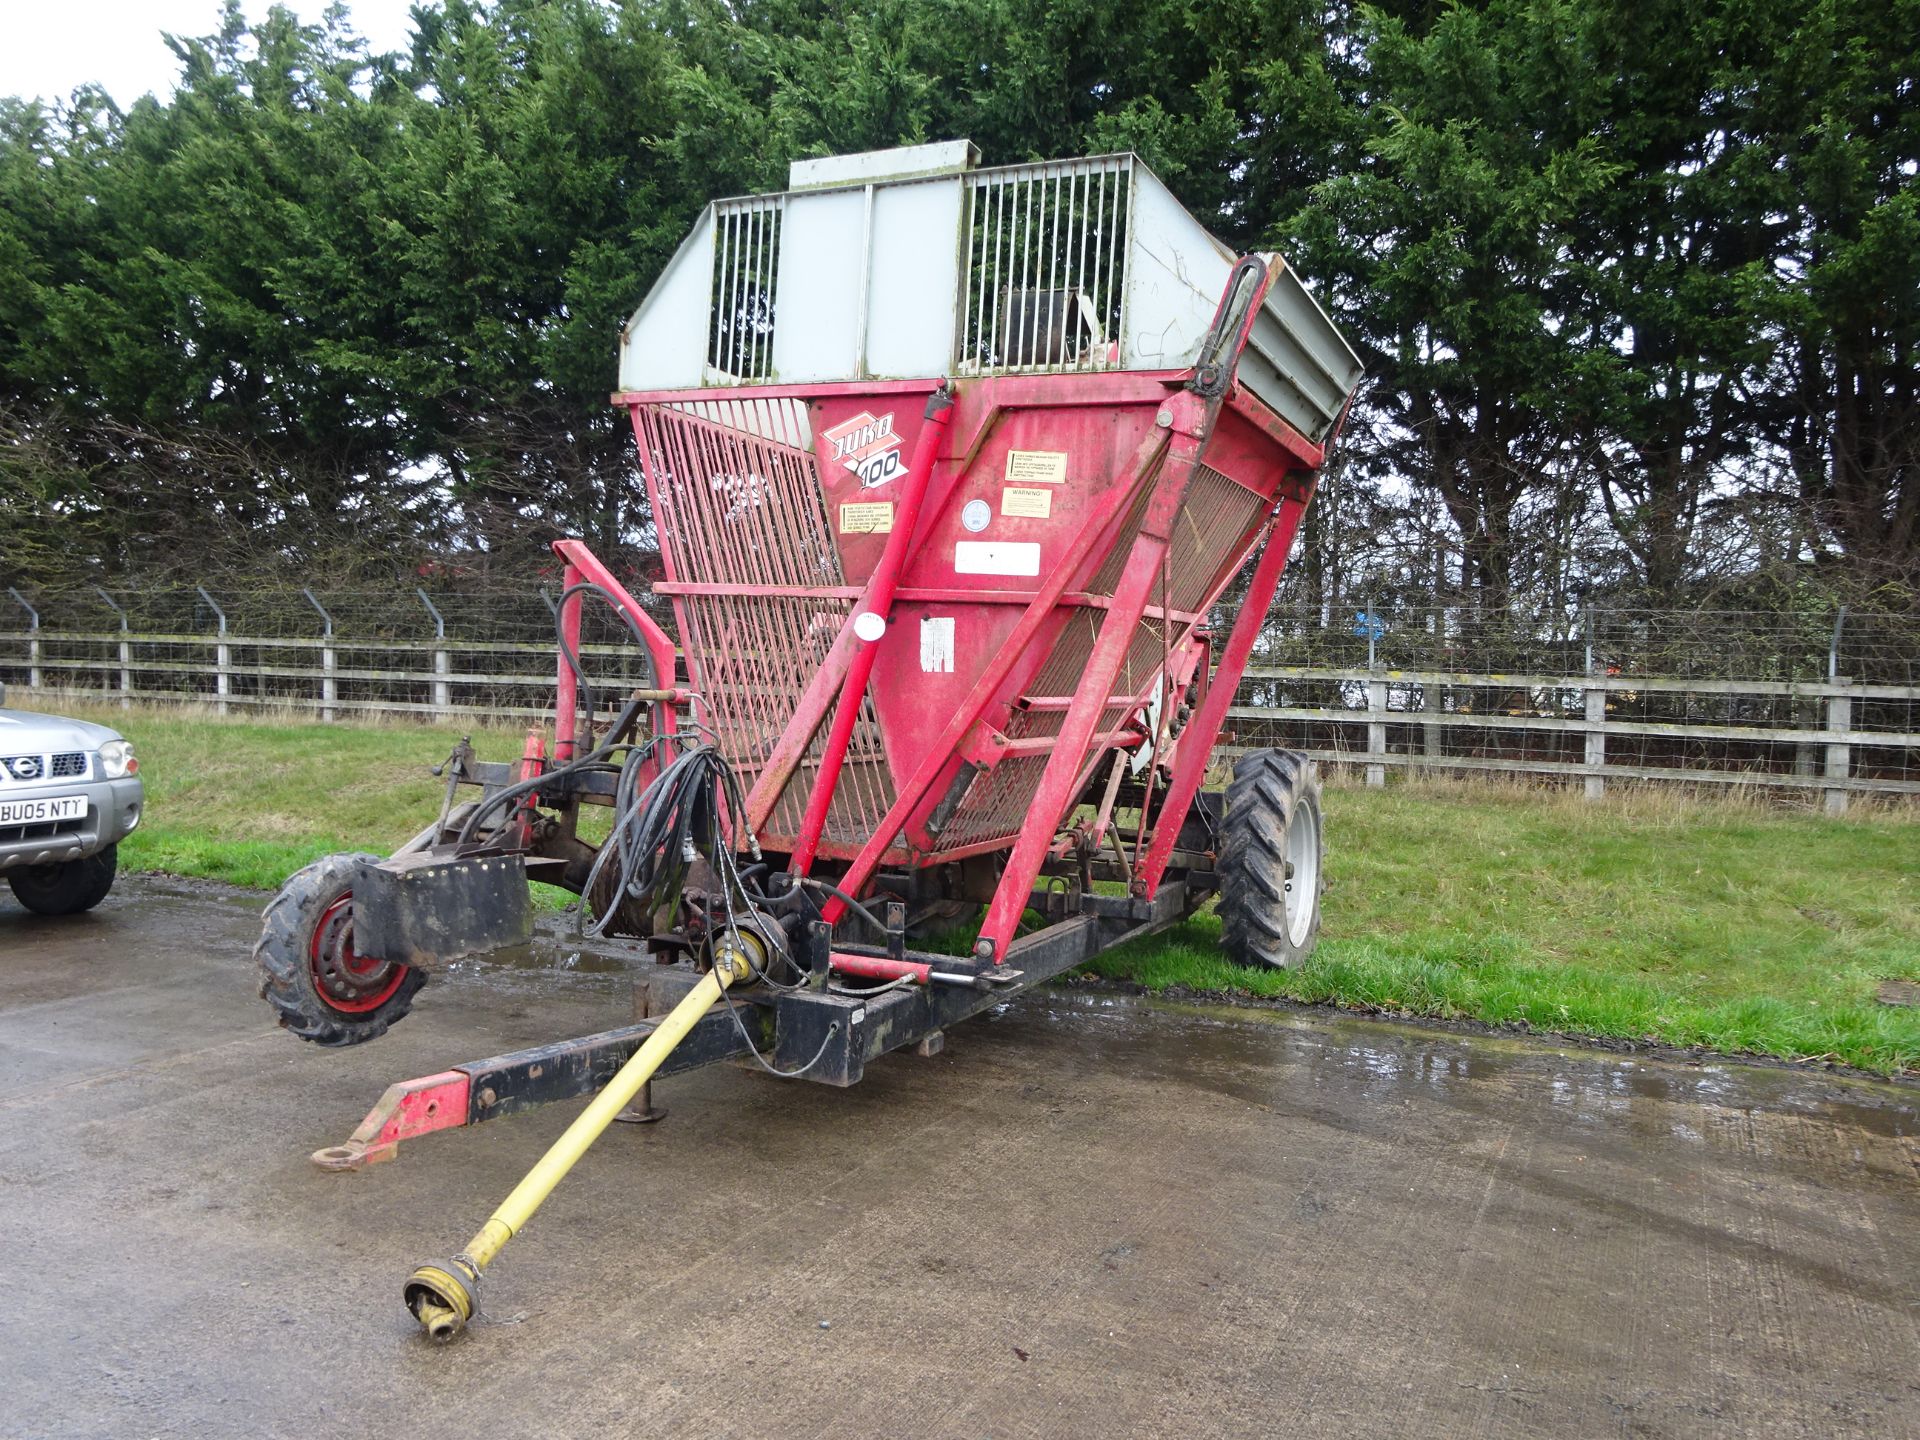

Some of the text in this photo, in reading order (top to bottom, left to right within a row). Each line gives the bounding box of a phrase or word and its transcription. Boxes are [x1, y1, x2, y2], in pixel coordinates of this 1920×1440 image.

[832, 413, 893, 462] JUKO
[860, 451, 899, 487] 100
[1012, 488, 1043, 497] WARNING!
[1, 799, 81, 821] BU05 NTY
